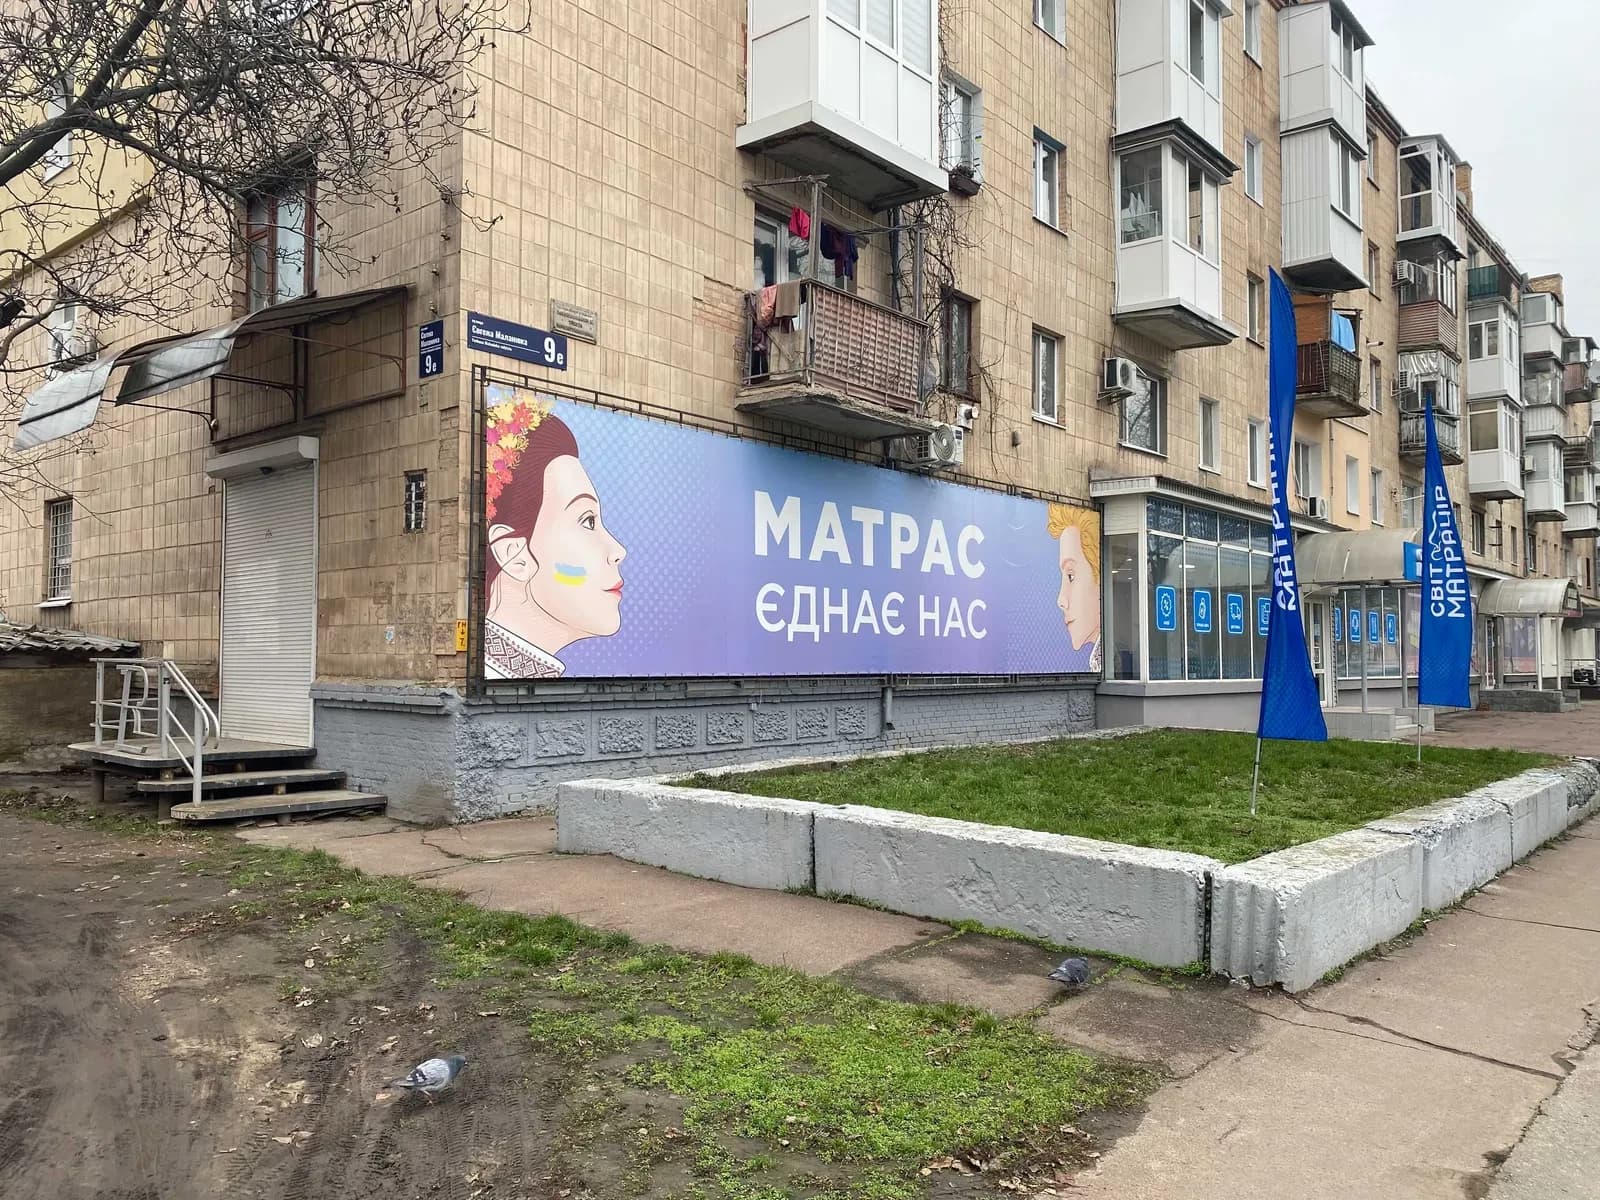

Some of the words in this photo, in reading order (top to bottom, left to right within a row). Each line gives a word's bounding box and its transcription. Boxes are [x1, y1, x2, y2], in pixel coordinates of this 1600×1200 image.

[754, 490, 986, 579] МАТРАС
[755, 582, 906, 643] ЄДНАЄ
[919, 594, 988, 640] НАС
[1430, 563, 1446, 618] СВІТ
